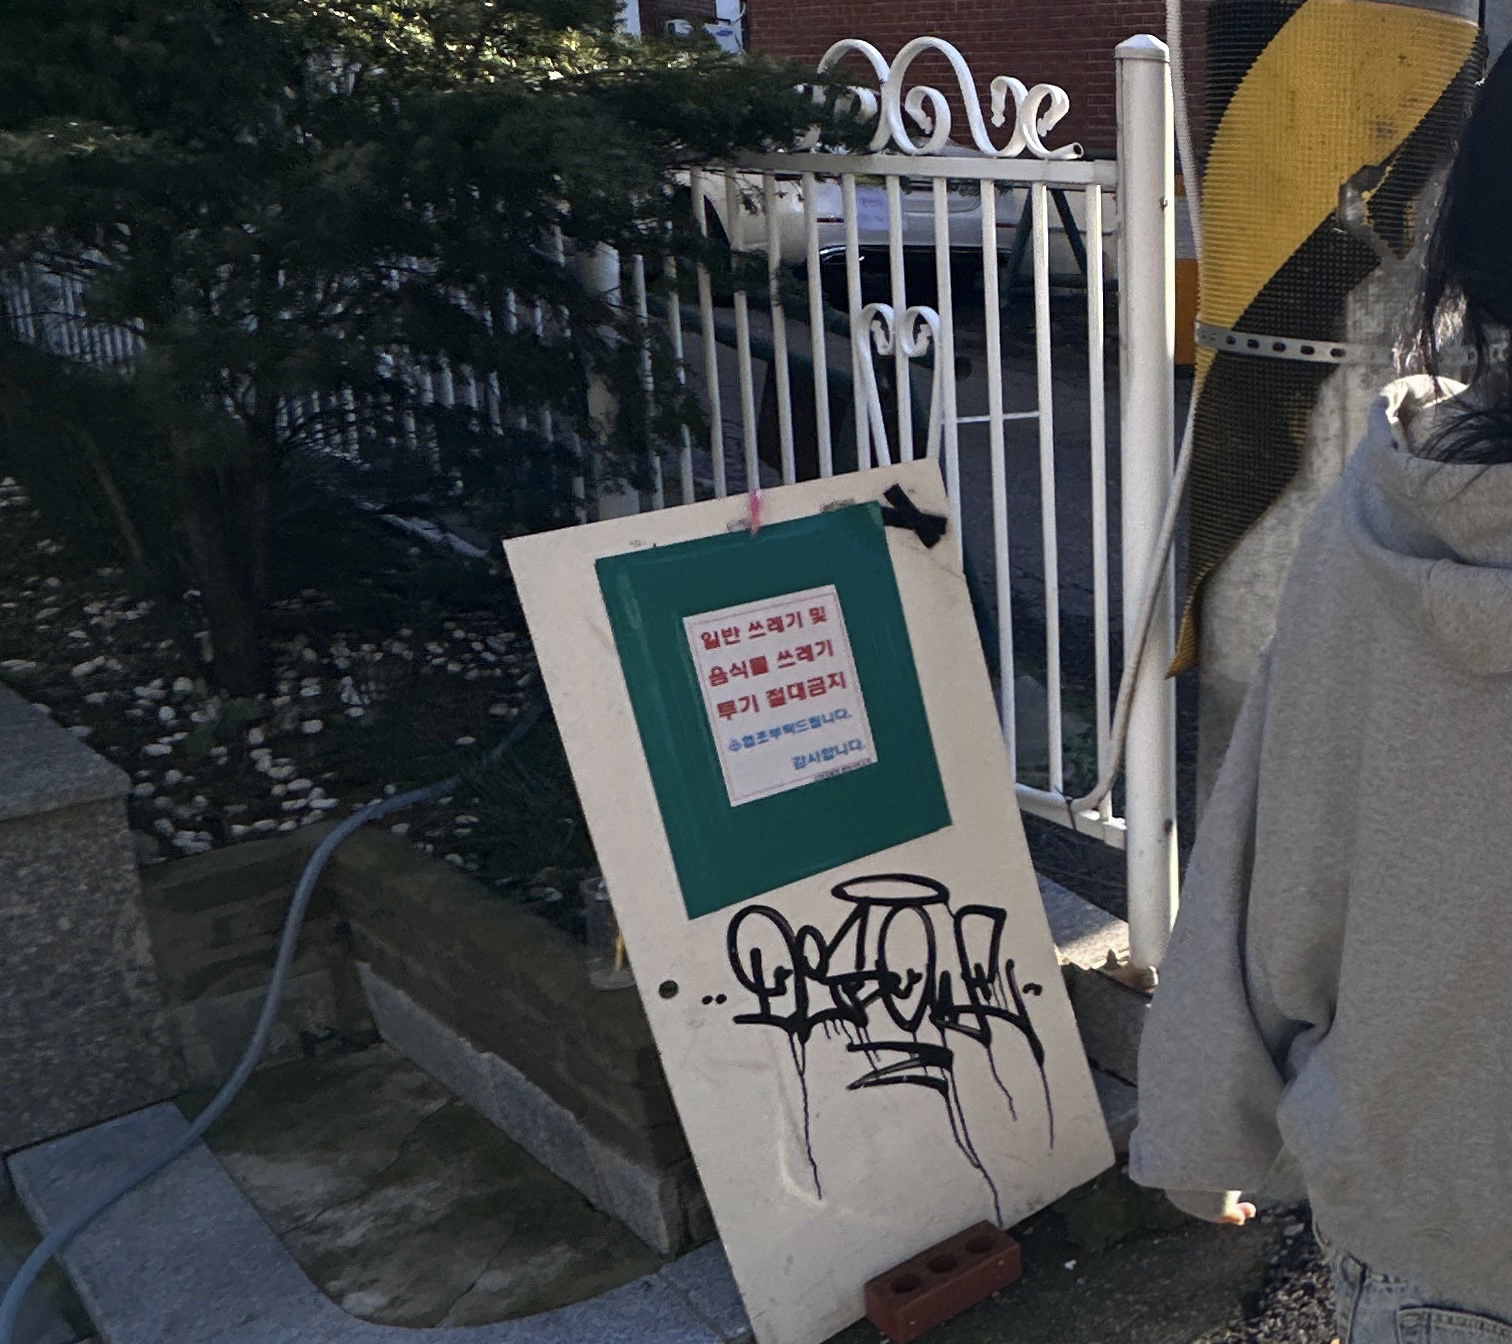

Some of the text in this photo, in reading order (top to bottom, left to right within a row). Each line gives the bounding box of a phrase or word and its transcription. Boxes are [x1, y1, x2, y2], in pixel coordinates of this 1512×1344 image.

[700, 606, 827, 650] 일반 쓰레기 및
[777, 639, 835, 669] 쓰레기
[717, 671, 847, 720] 투기 절대금지
